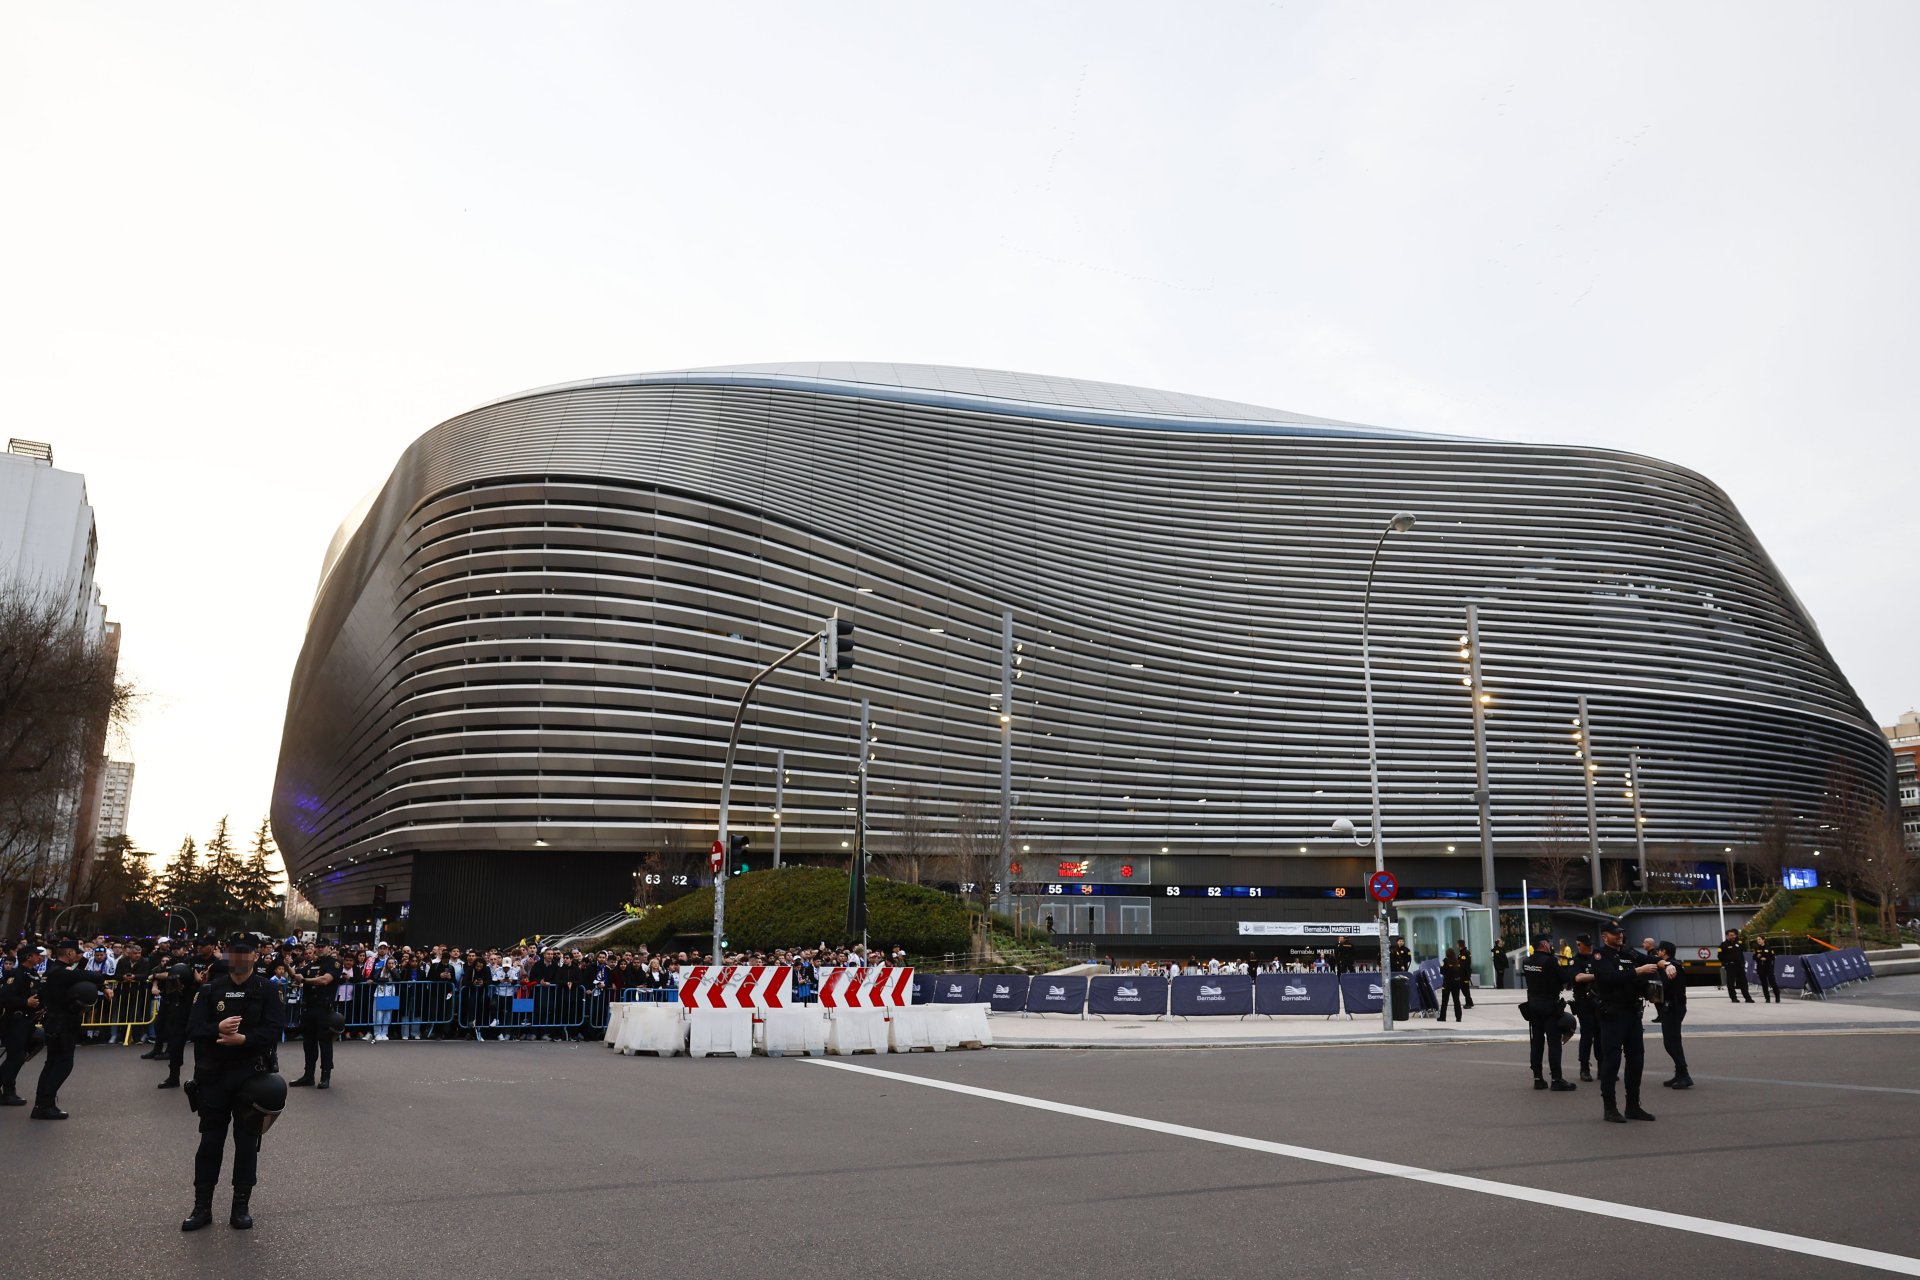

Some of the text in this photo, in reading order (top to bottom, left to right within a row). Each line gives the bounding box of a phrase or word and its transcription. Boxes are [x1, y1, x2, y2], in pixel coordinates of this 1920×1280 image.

[645, 874, 661, 884] 63
[1048, 884, 1063, 894] 55
[1081, 884, 1093, 894] 54
[1166, 886, 1180, 896] 53
[1207, 887, 1222, 897] 52
[1249, 887, 1262, 897] 51
[1335, 887, 1345, 897] 50
